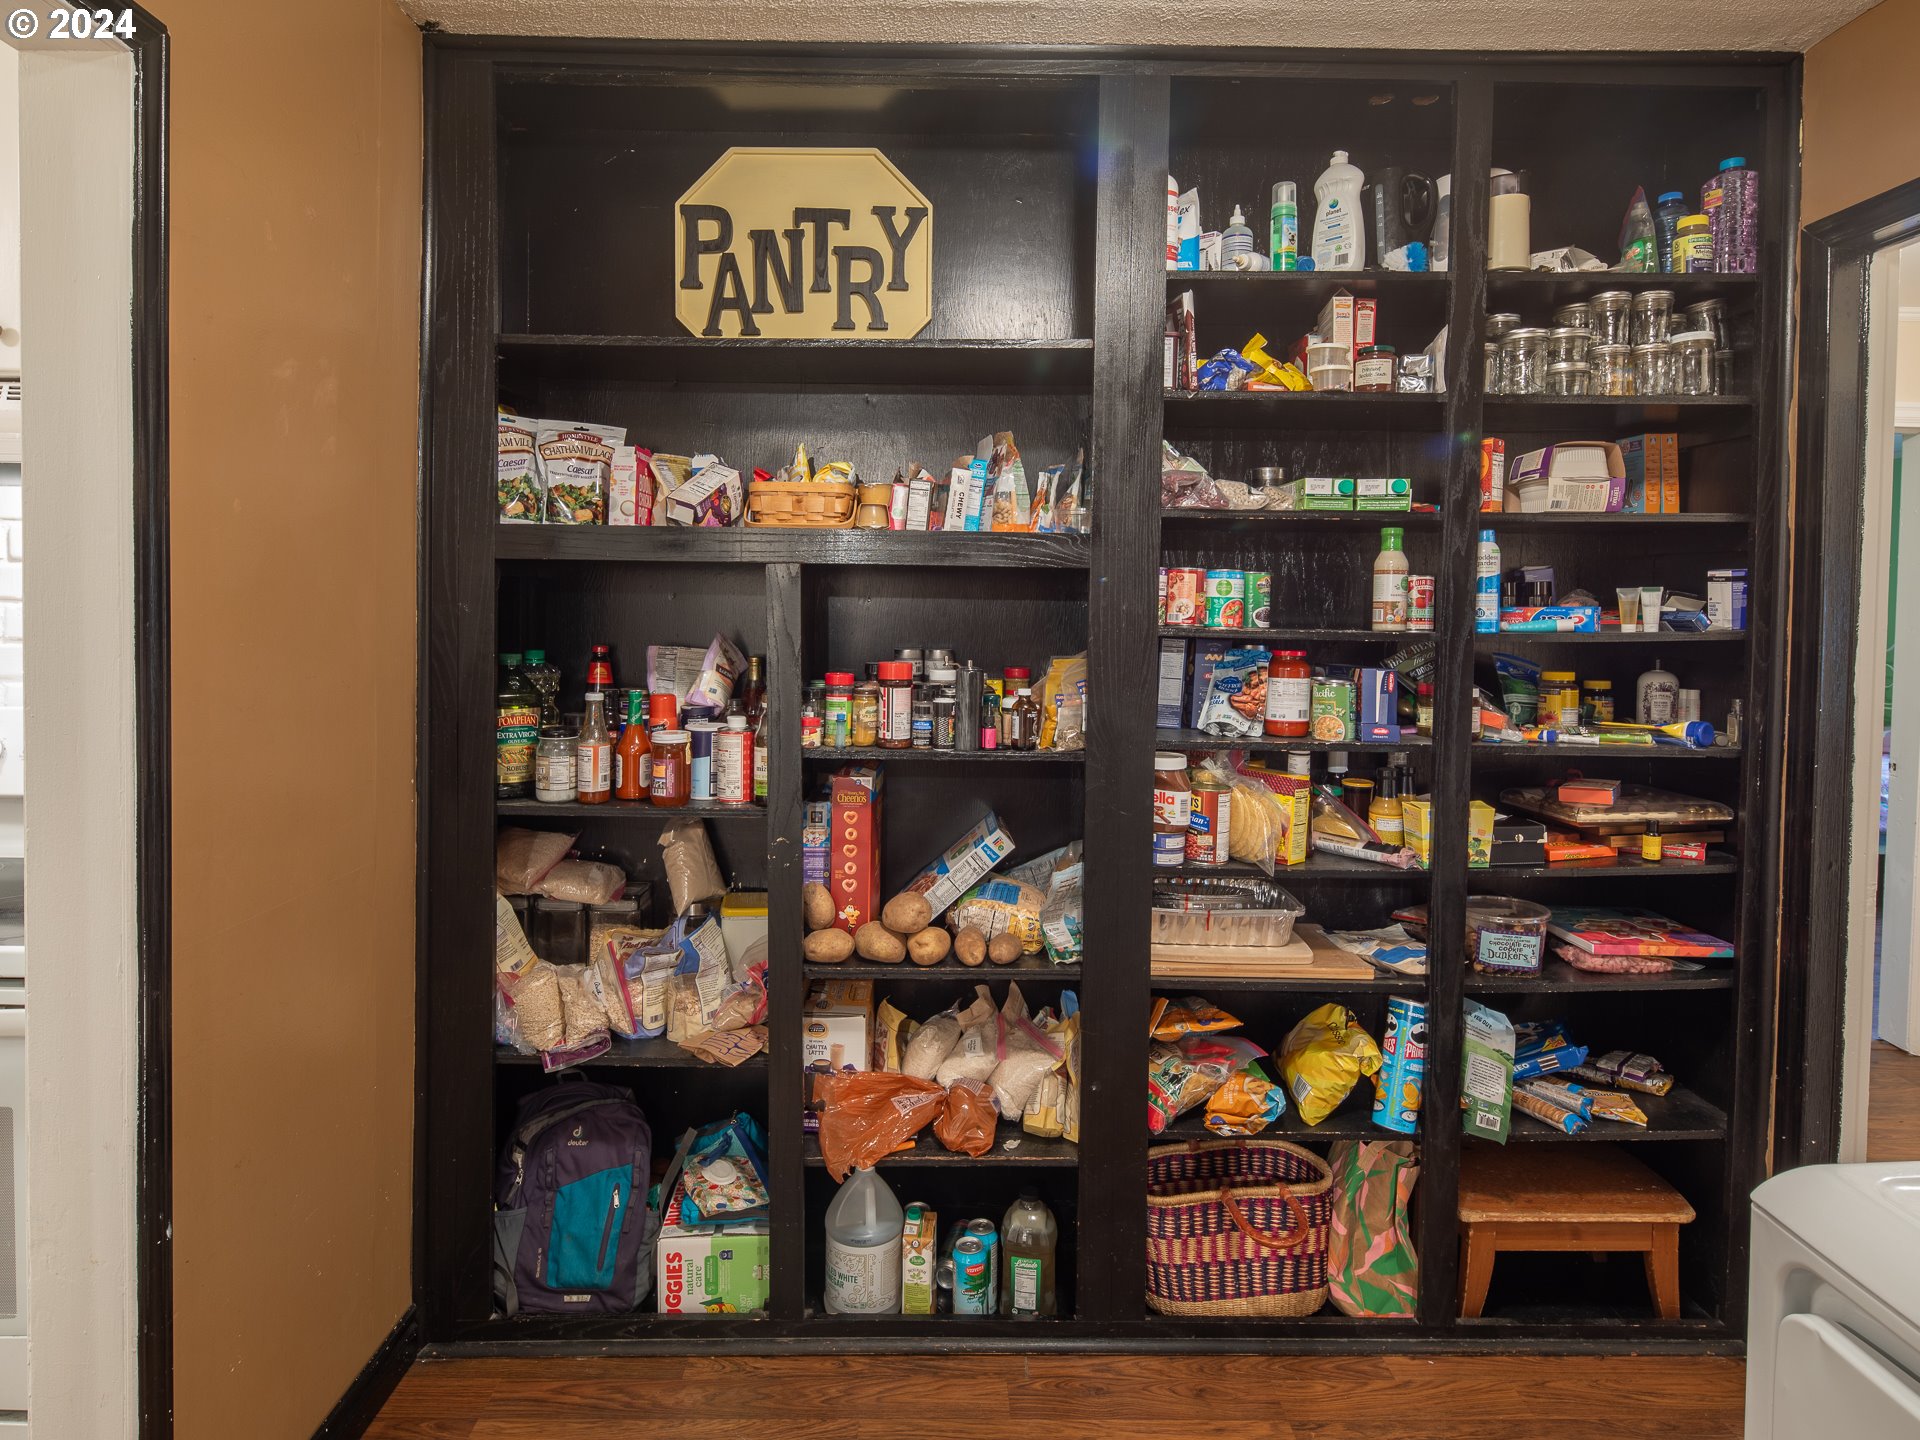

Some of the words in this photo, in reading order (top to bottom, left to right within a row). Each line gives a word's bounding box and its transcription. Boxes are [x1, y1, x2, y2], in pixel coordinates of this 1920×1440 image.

[1326, 208, 1342, 217] planet
[680, 204, 928, 336] PANTRY
[562, 433, 598, 443] HOMESTYLE
[544, 446, 584, 457] CHATHAM
[566, 464, 595, 476] Caesar
[957, 491, 966, 520] CHEWY
[498, 715, 536, 727] POMPEIAN
[497, 732, 517, 740] EXTRA
[518, 730, 537, 740] VIRGIN
[506, 765, 529, 773] ROBUST
[837, 793, 867, 804] Cheerios
[1489, 941, 1521, 949] CHOCOLATE
[1499, 946, 1524, 954] COOKIE
[1488, 948, 1529, 962] Dunkers
[686, 1259, 695, 1295] natural
[837, 1272, 858, 1284] WHITE
